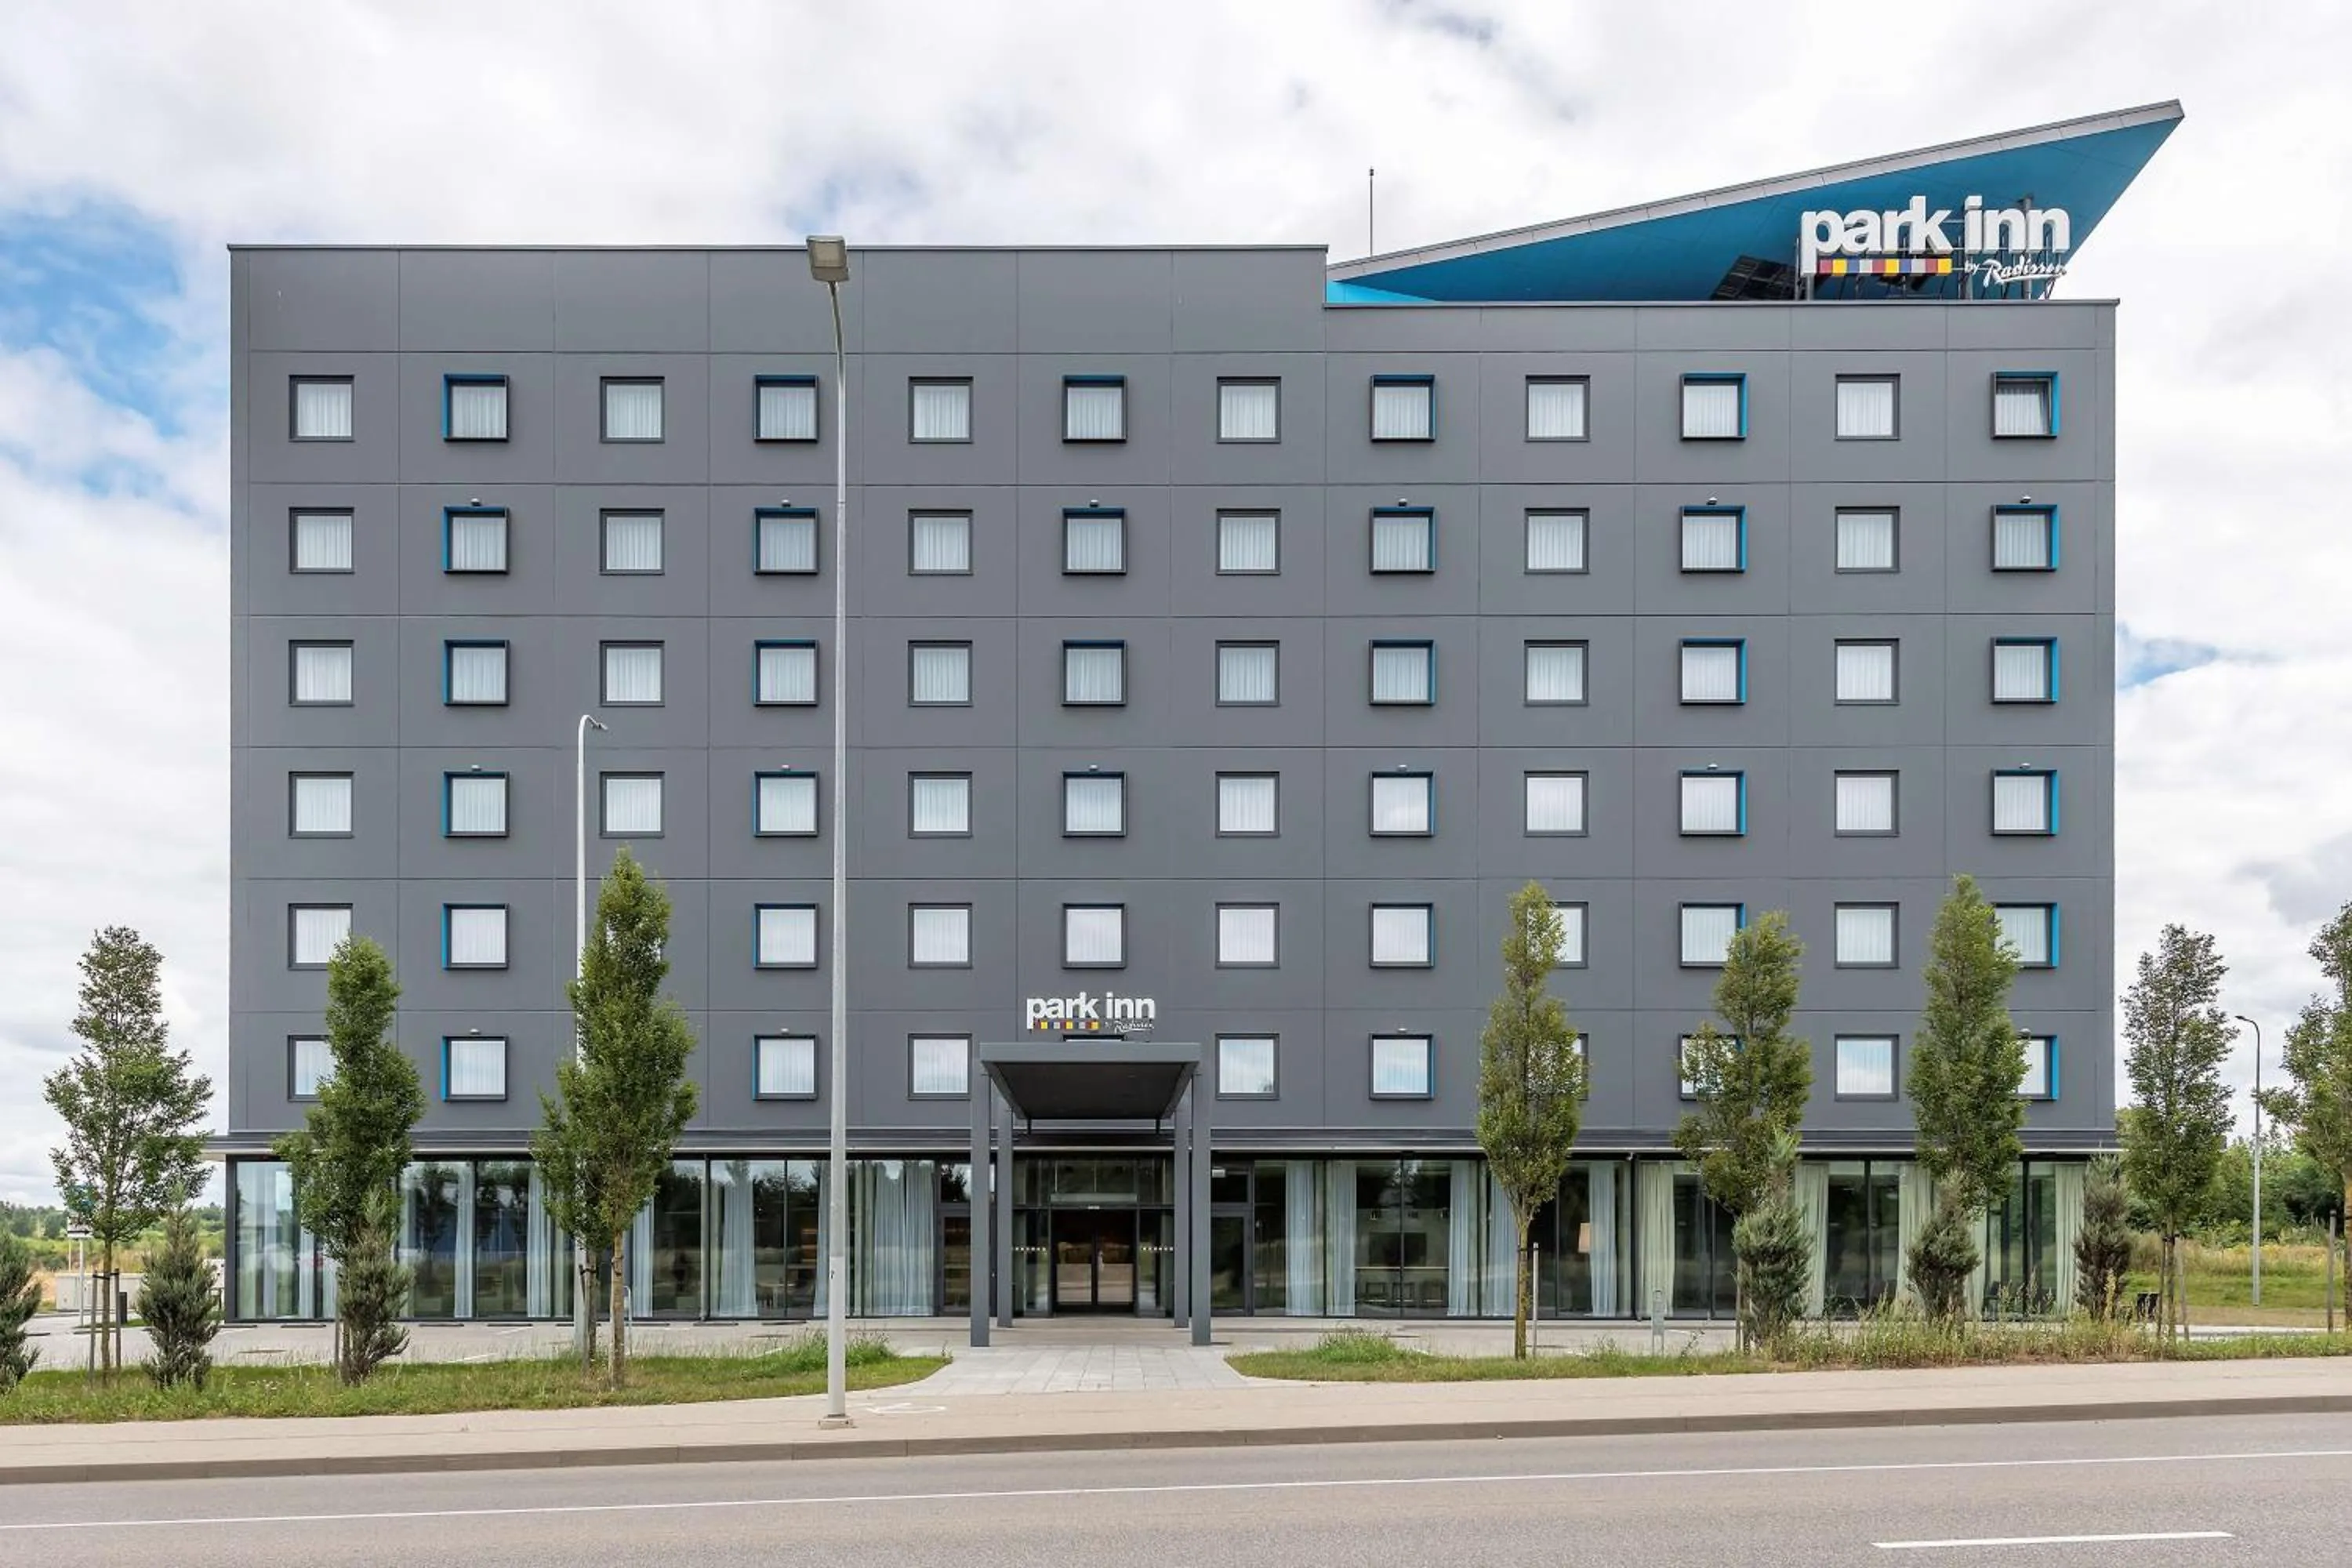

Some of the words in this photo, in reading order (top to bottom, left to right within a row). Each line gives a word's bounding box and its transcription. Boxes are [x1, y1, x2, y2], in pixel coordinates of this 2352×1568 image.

[1801, 195, 1955, 278] park
[1965, 195, 2071, 254] inn
[1026, 992, 1099, 1029] park
[1106, 991, 1155, 1019] inn
